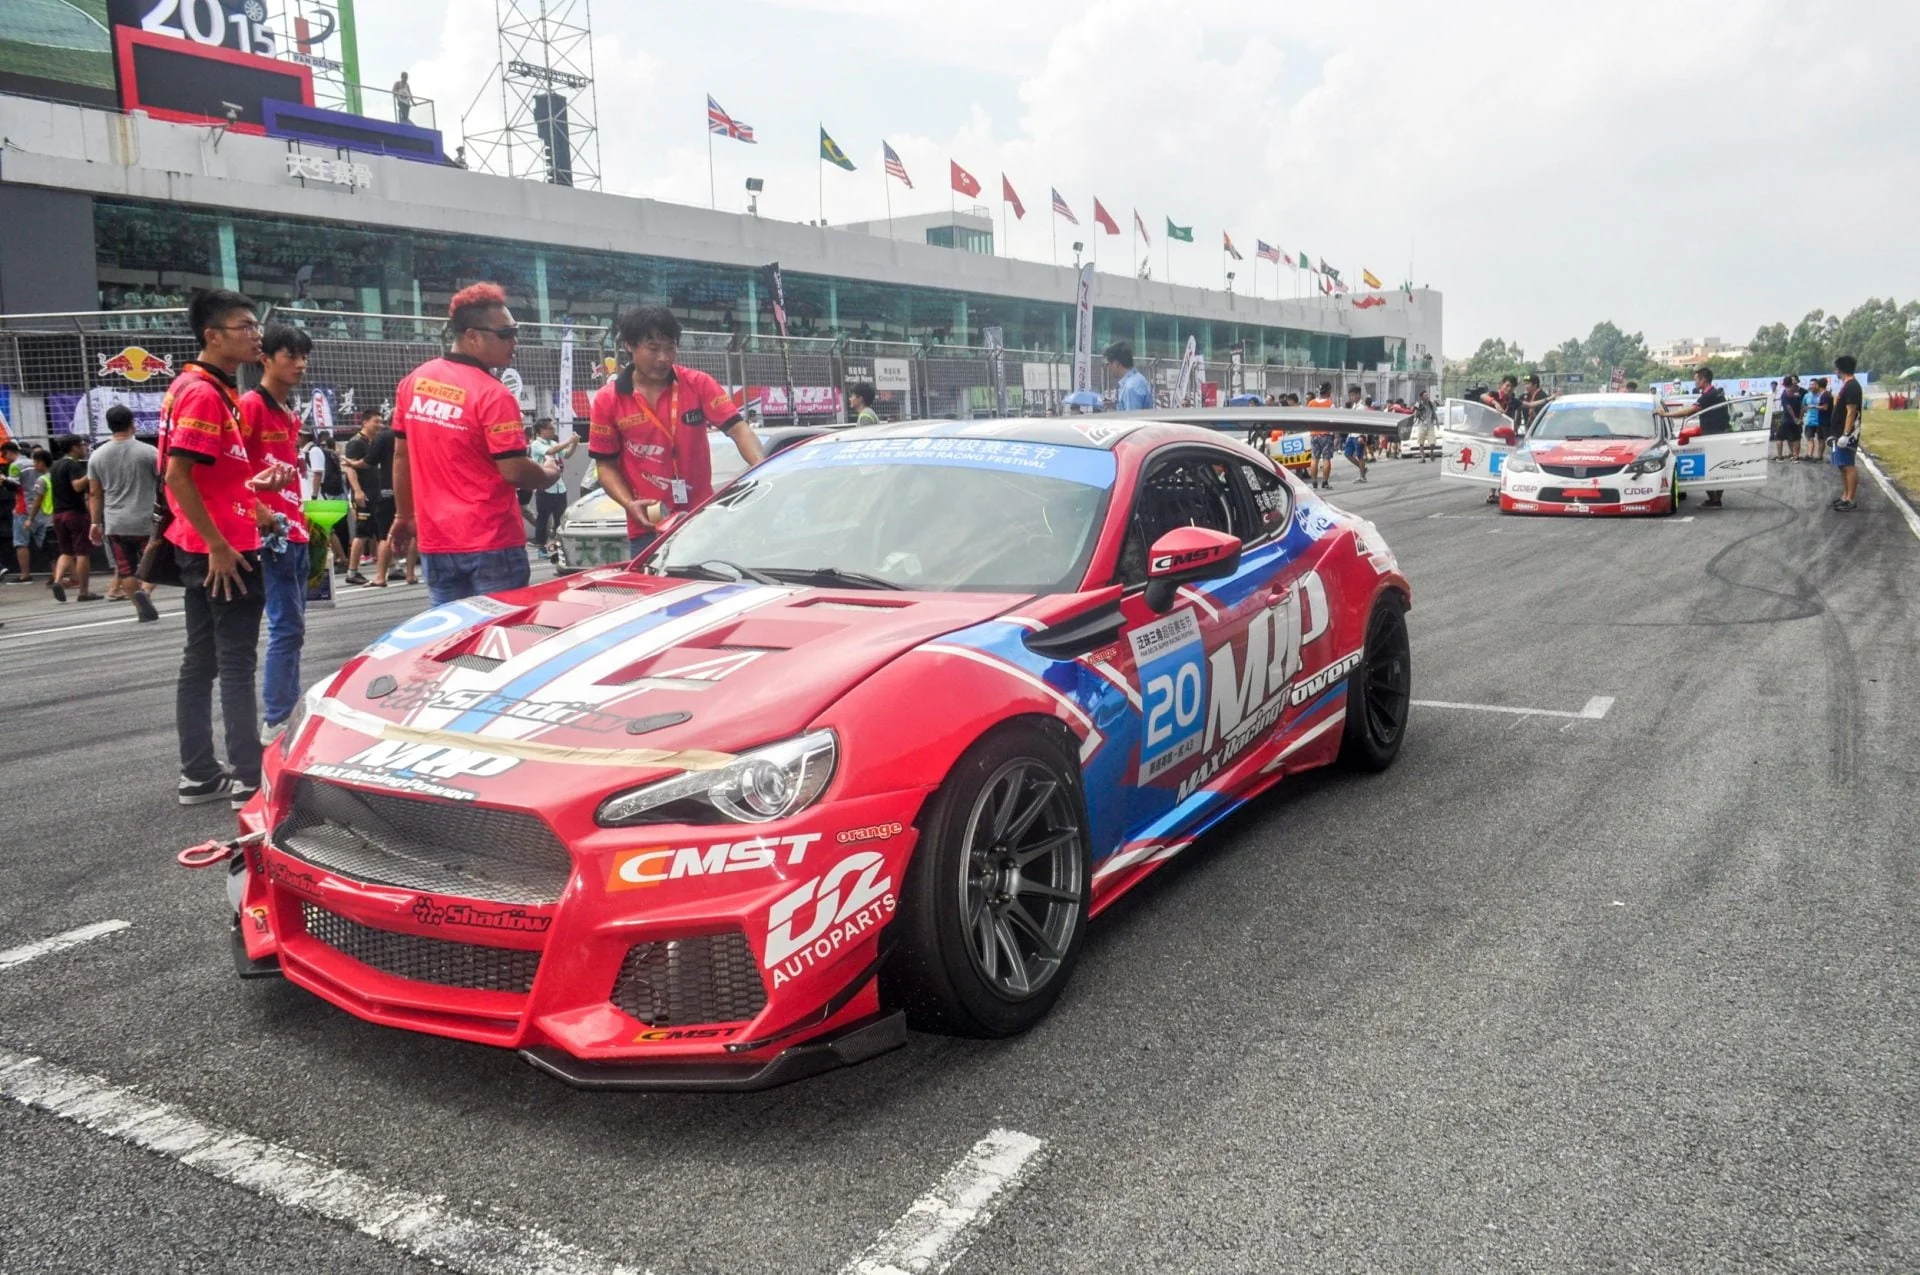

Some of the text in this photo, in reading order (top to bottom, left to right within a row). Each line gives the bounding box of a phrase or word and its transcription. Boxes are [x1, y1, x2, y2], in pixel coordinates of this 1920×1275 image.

[141, 0, 277, 59] 2015
[1283, 440, 1302, 454] 59
[936, 451, 985, 461] RACING
[986, 456, 1047, 469] FESTIVAL
[1680, 459, 1695, 475] 2
[1156, 545, 1224, 569] CMST
[1147, 662, 1200, 748] 20
[303, 764, 342, 778] MAX
[1176, 751, 1225, 806] MAX
[836, 822, 902, 843] orange
[618, 832, 823, 883] CMST
[772, 892, 897, 989] AUTOPARTS
[641, 1026, 745, 1040] CMST
